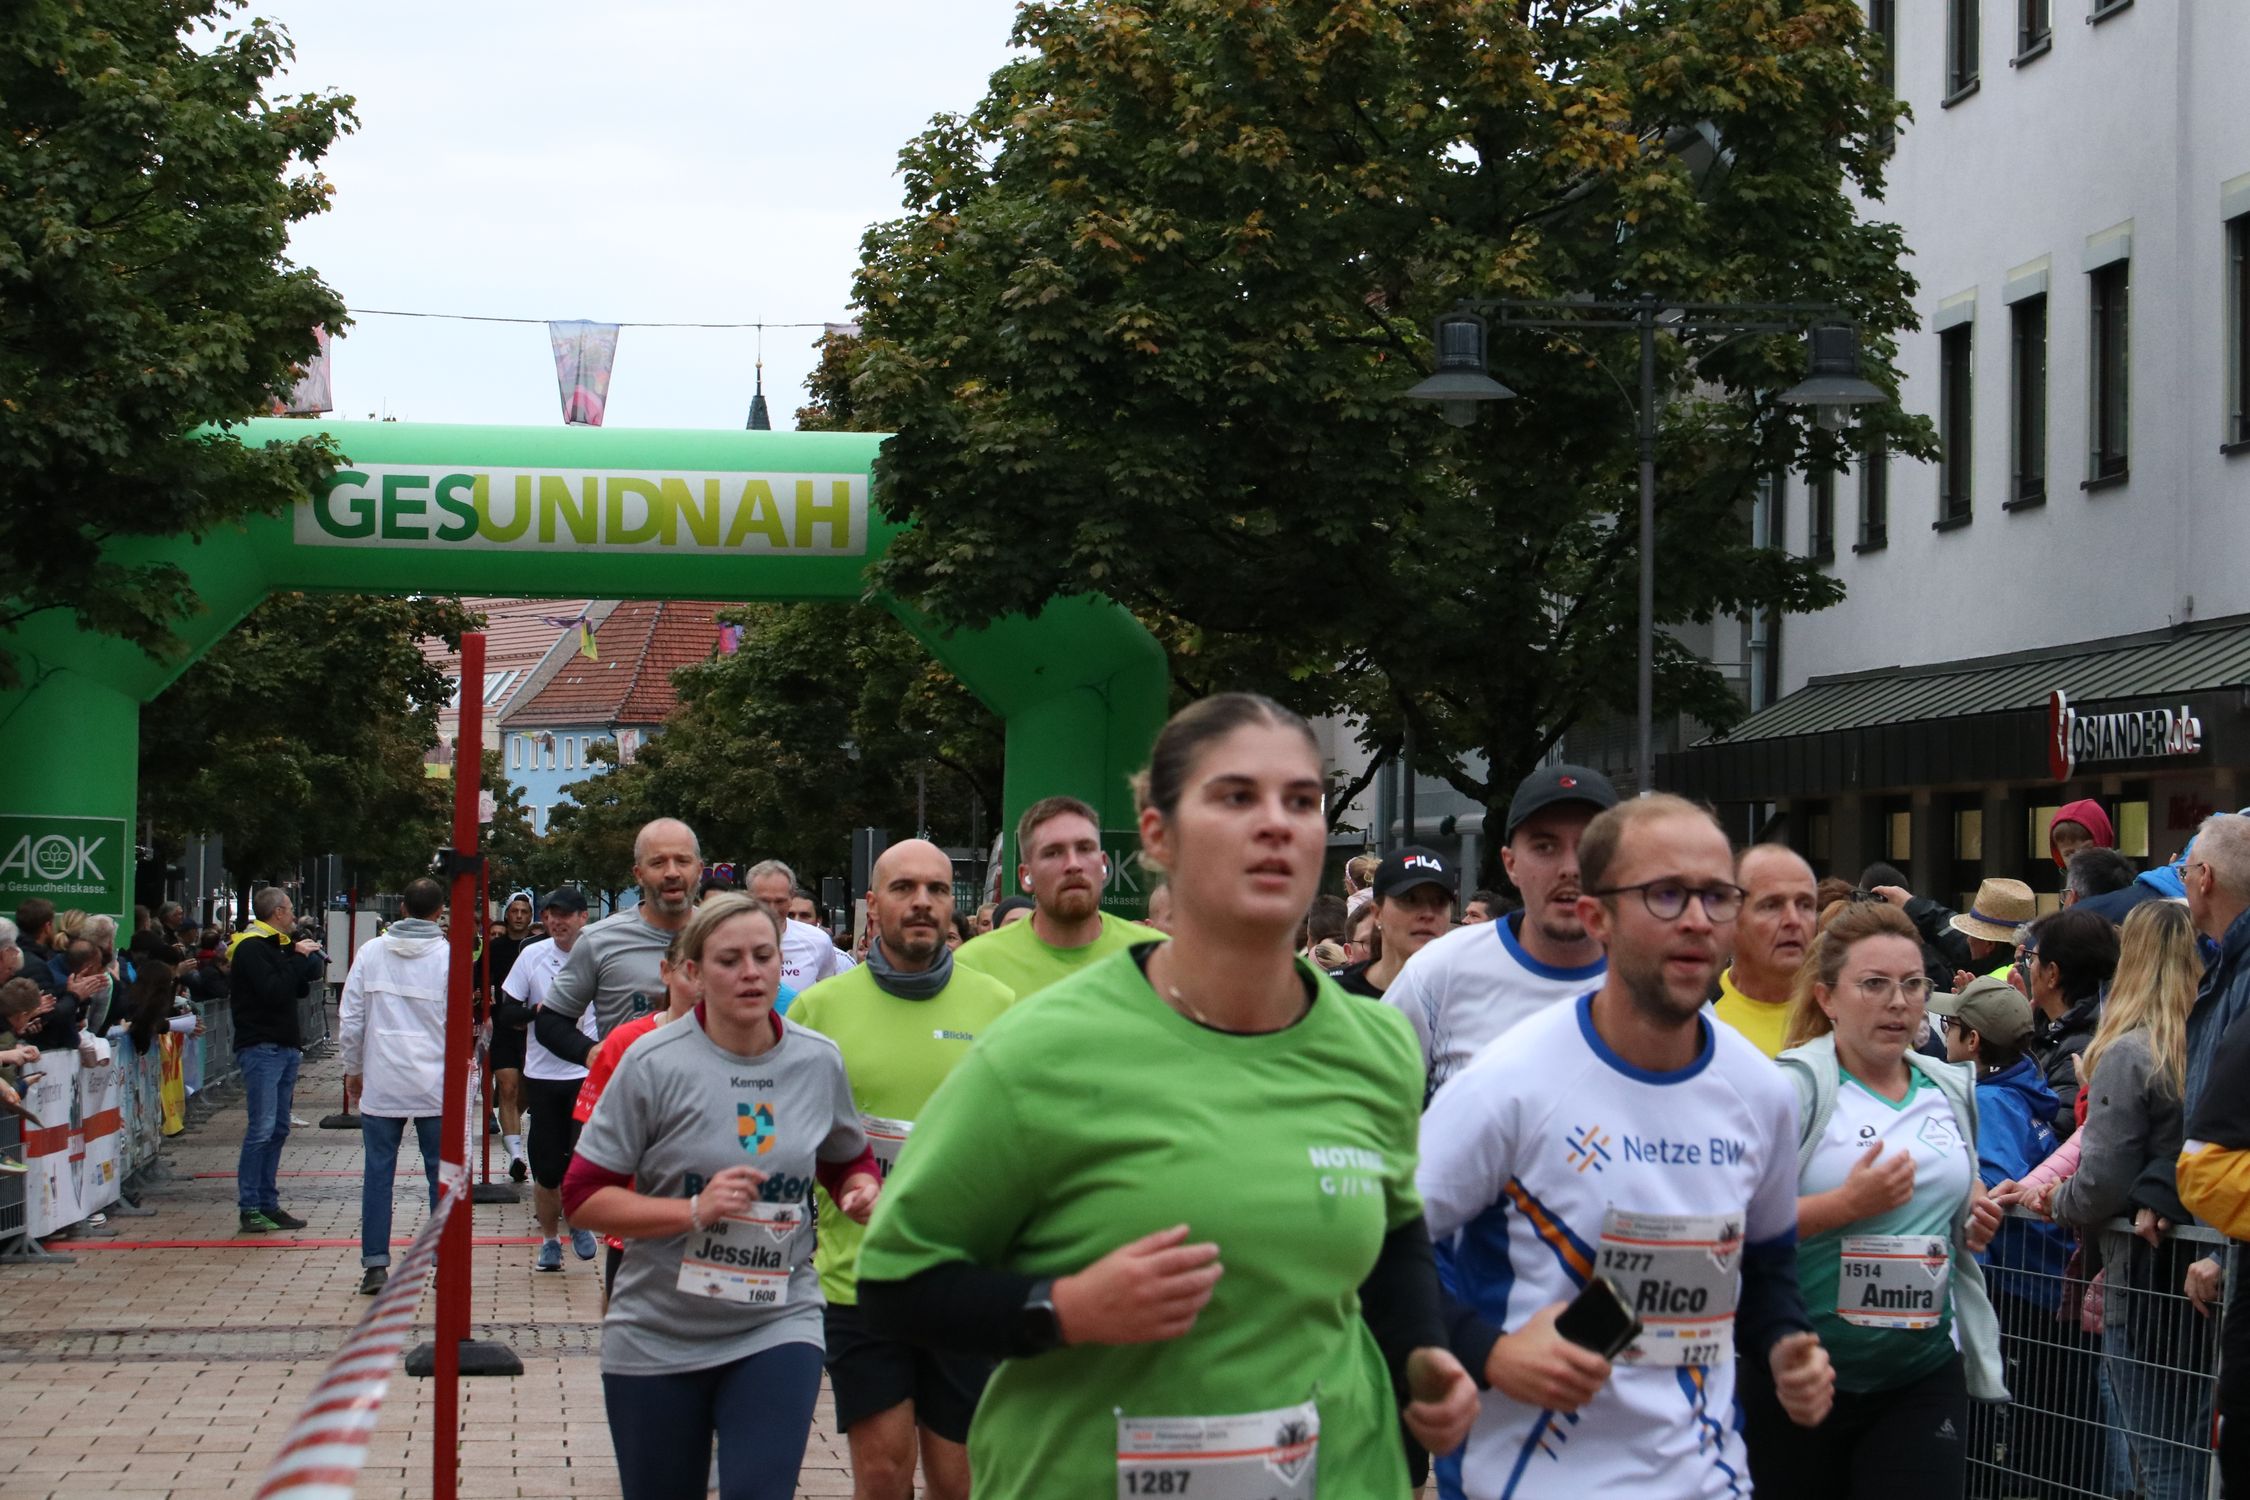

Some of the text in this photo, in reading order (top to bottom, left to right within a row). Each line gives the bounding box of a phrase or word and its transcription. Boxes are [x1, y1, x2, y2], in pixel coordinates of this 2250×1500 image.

[313, 470, 850, 548] GESUNDNAH
[0, 834, 106, 880] AOK
[1403, 855, 1443, 872] FILA
[942, 1030, 974, 1041] Blickle
[730, 1076, 774, 1091] Kempa
[1623, 1135, 1745, 1167] Netze BW
[695, 1237, 782, 1269] Jessika
[1603, 1249, 1655, 1273] 1277
[1844, 1263, 1882, 1278] 1514
[749, 1289, 777, 1302] 1608
[1635, 1279, 1708, 1314] Rico
[1860, 1283, 1934, 1309] Amira
[1681, 1343, 1720, 1364] 1277
[1125, 1470, 1191, 1494] 1287
